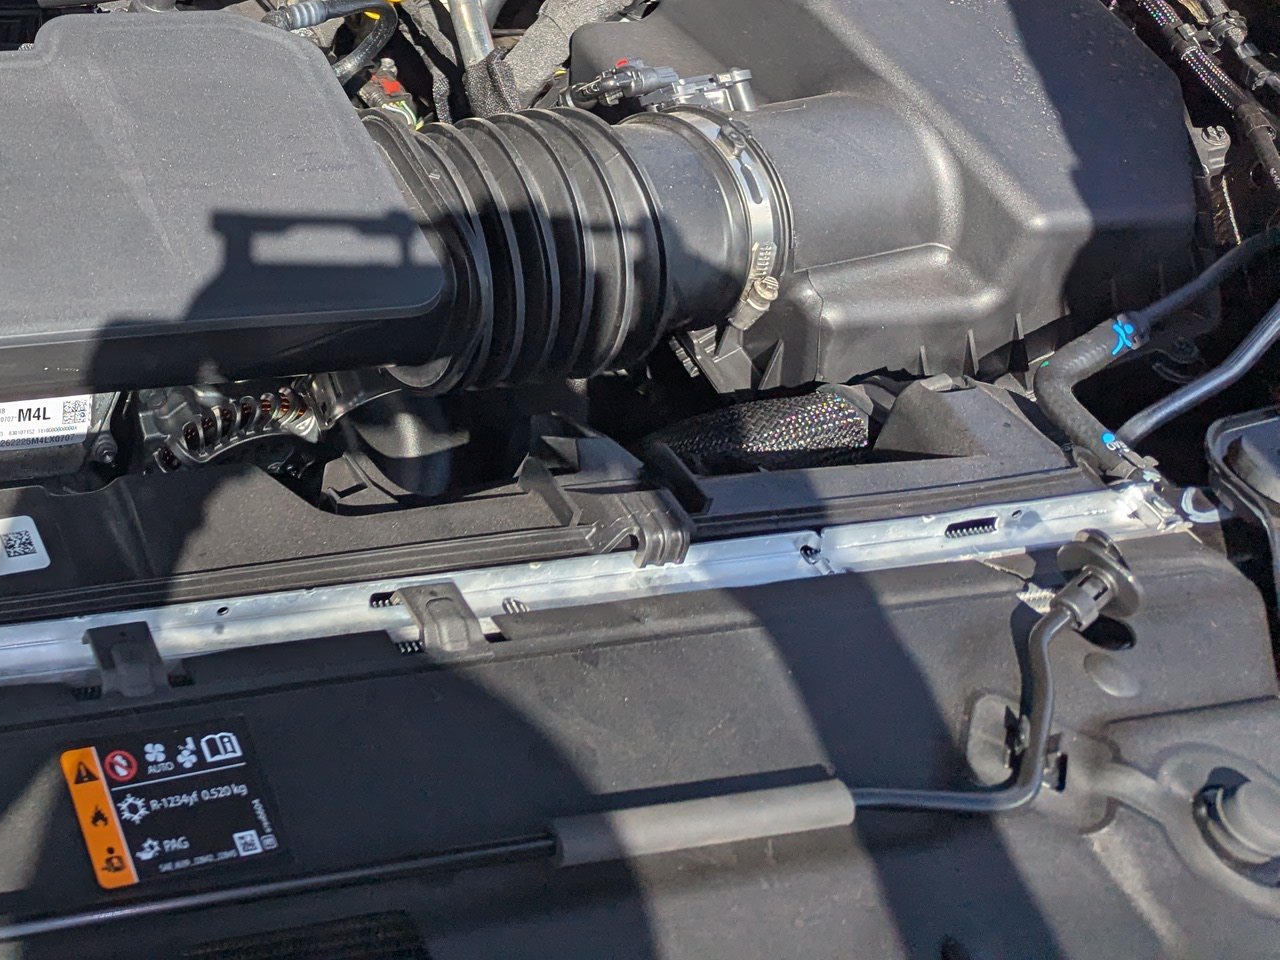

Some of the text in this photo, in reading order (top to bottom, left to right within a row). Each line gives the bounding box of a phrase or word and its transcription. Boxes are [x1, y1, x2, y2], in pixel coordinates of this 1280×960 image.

[17, 406, 51, 422] M4L
[147, 761, 175, 774] AUTO
[149, 783, 249, 811] R-1234yf 0.520 kg
[162, 836, 190, 852] PAG
